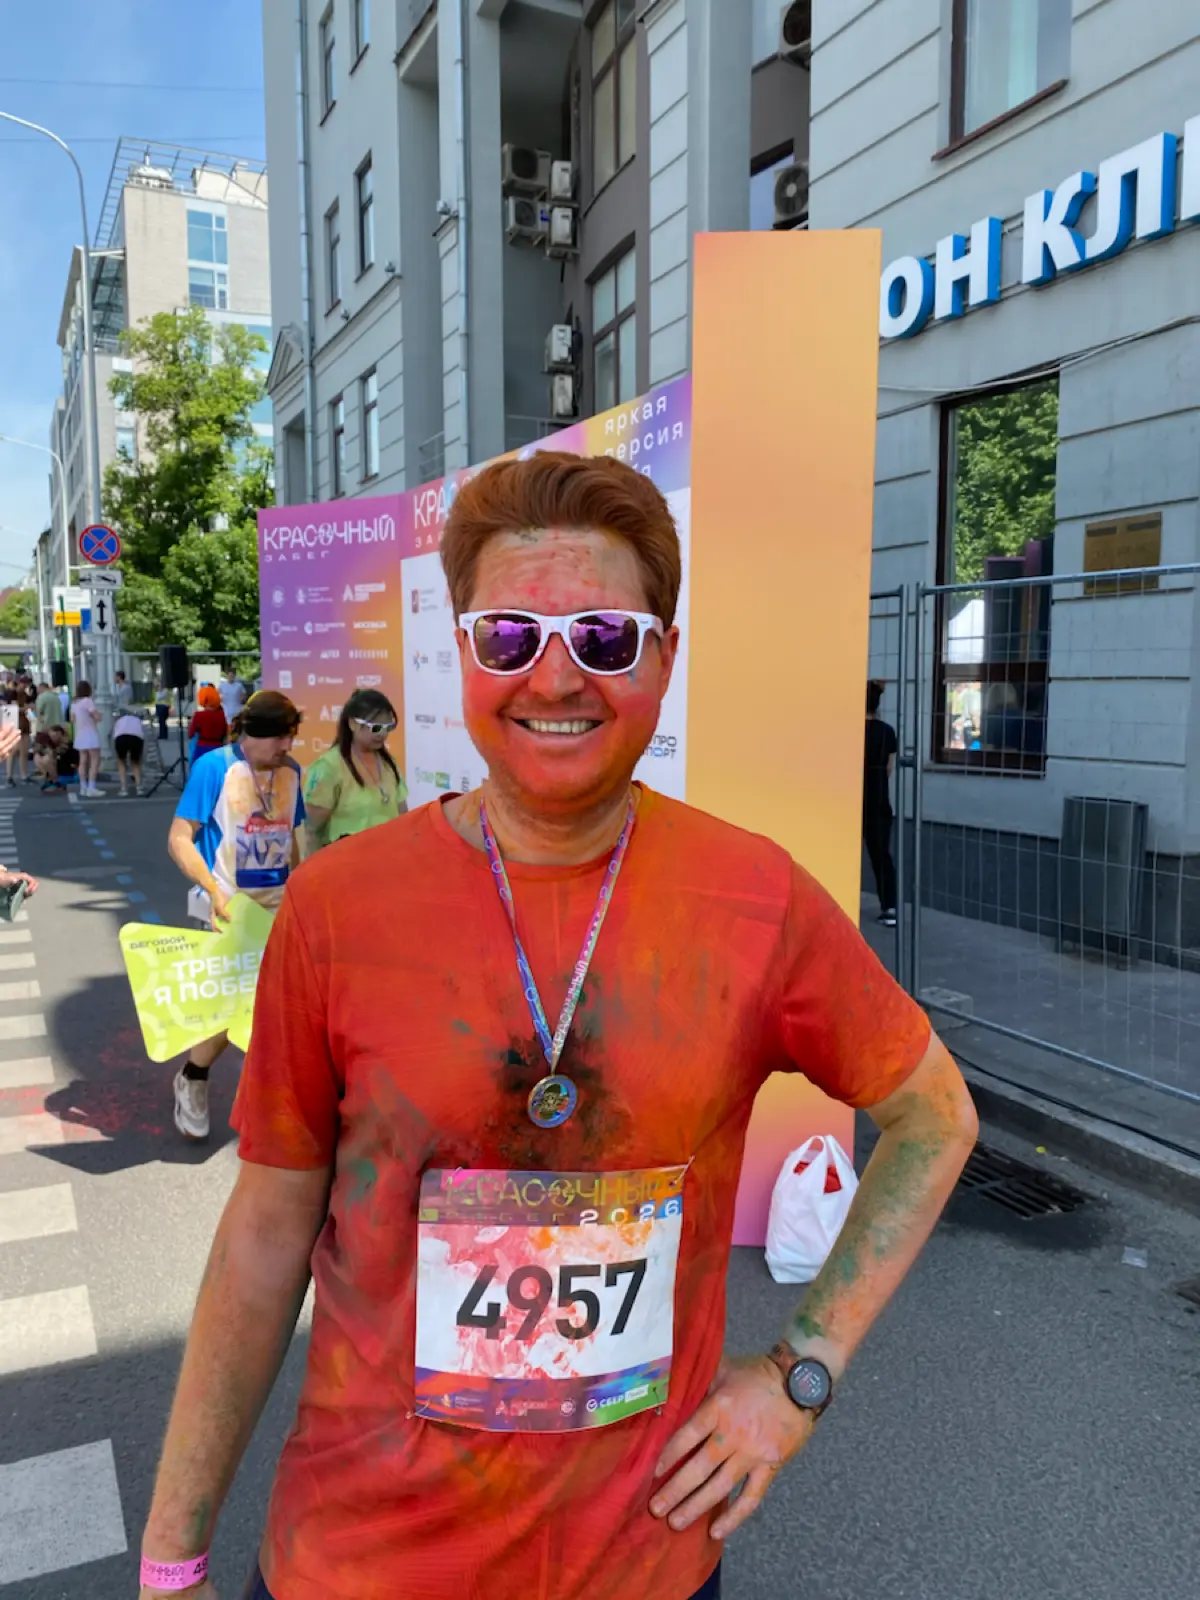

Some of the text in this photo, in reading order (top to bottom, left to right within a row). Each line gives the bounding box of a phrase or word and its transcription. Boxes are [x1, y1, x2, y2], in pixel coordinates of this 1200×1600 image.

[1022, 114, 1200, 286] КЛ
[604, 395, 668, 437] яркая
[263, 513, 396, 551] КРАСОЧНЫЙ
[264, 550, 330, 563] ЗАБЕГ
[653, 734, 677, 757] ПРО
[154, 973, 258, 1006] Я ПОБЕ
[579, 1198, 679, 1226] 2026
[456, 1259, 648, 1341] 4957
